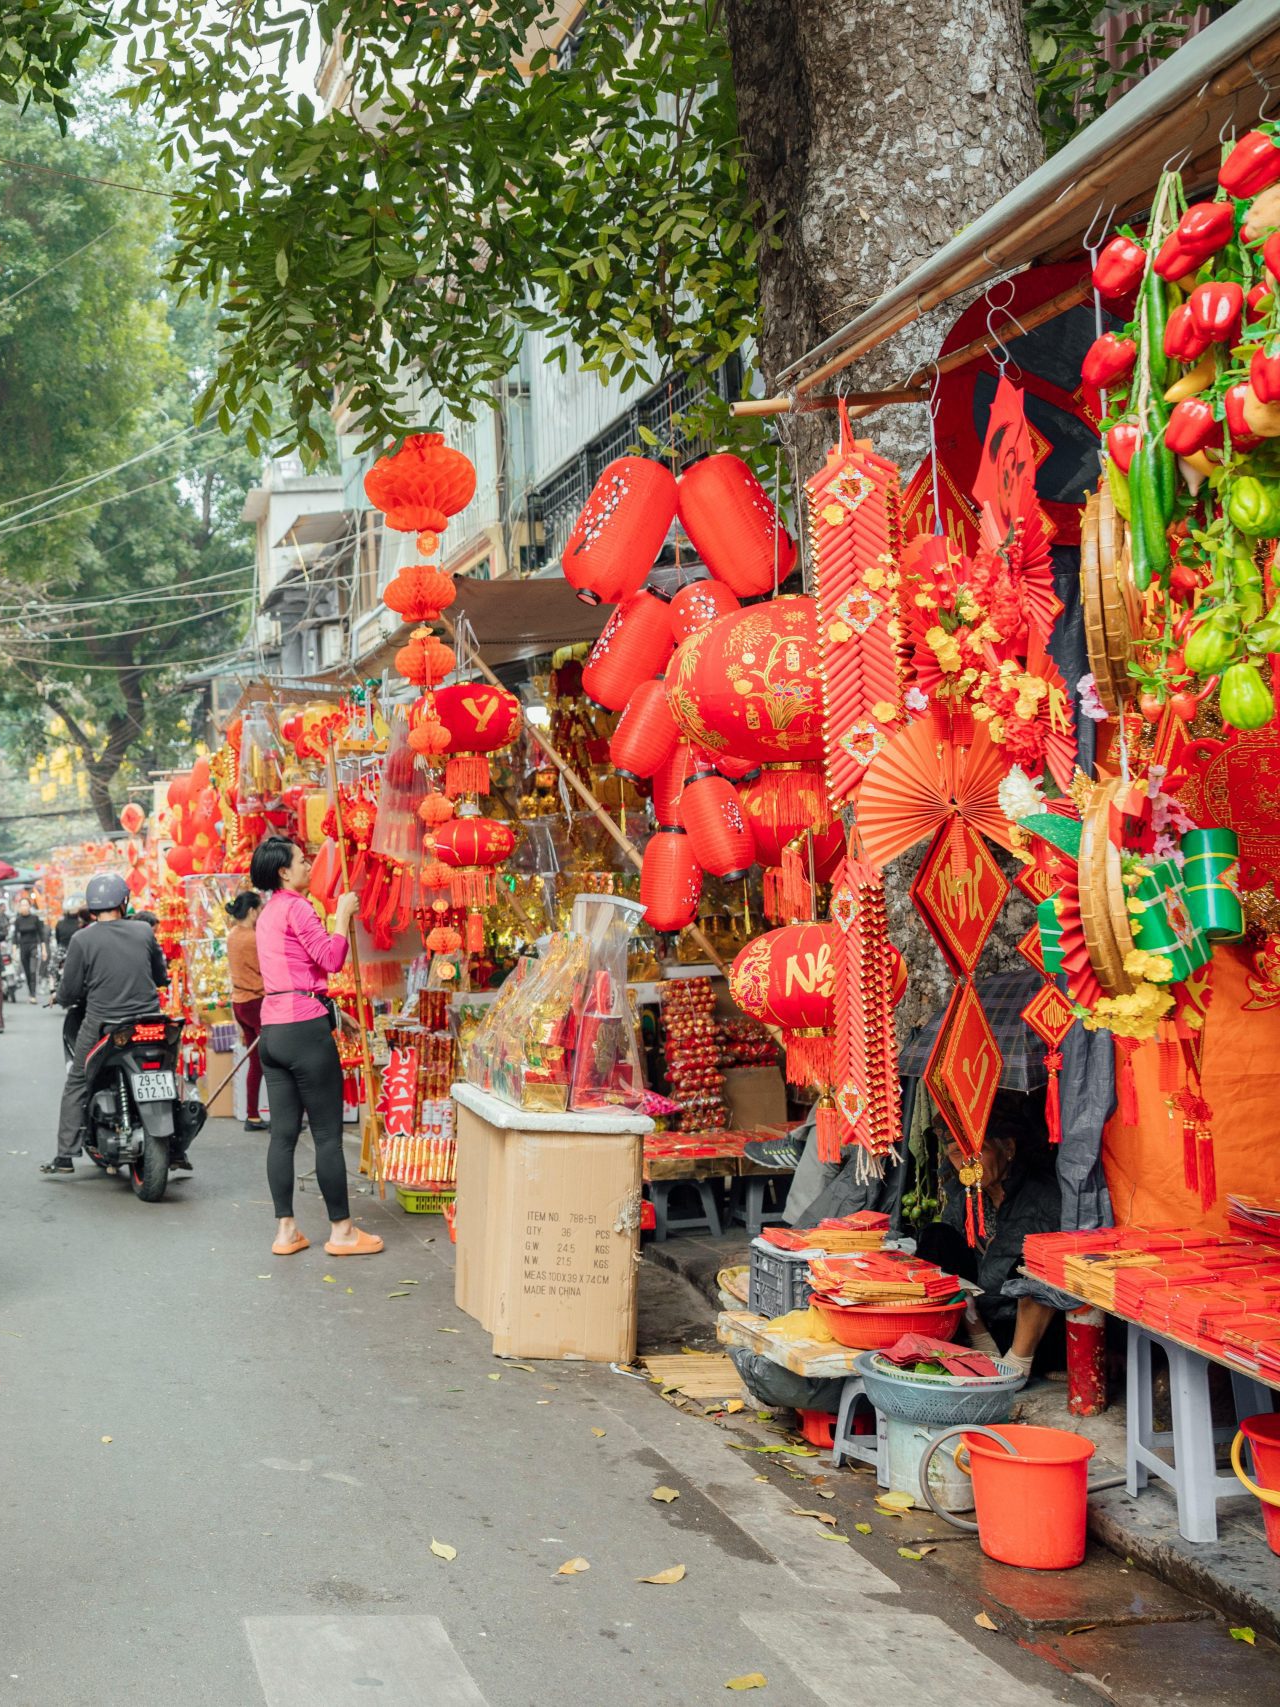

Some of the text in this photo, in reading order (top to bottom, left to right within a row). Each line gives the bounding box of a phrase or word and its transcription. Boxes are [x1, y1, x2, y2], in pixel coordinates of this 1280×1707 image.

[139, 1074, 167, 1087] 29-C1
[137, 1086, 173, 1099] 612.10
[527, 1211, 546, 1221] ITEM
[561, 1227, 572, 1238] 36
[595, 1230, 610, 1240] PCS
[595, 1245, 610, 1255] KGS
[593, 1259, 609, 1269] KGS
[524, 1285, 581, 1297] MADE IN CHINA
